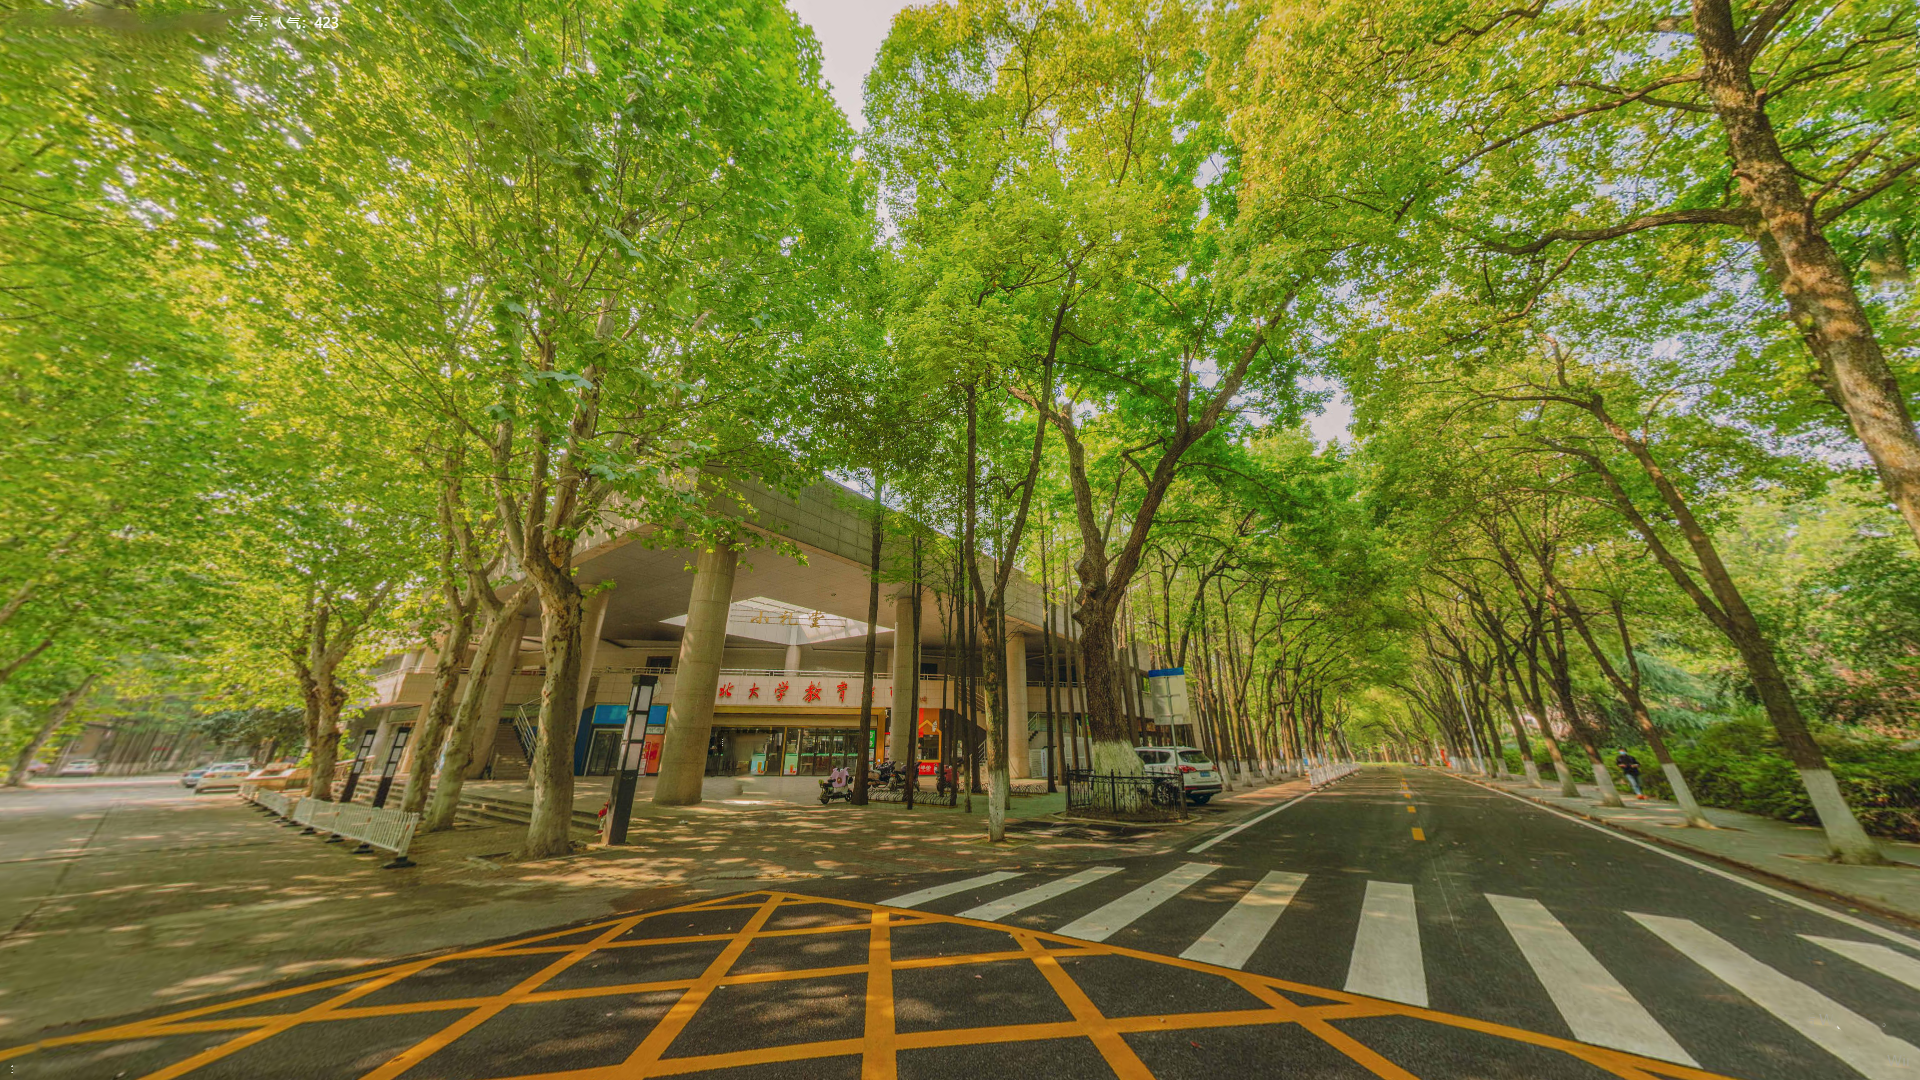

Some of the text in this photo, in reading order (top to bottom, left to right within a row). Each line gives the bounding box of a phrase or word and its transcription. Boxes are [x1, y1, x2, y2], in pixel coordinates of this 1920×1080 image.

[719, 680, 893, 703] 北大学教育
